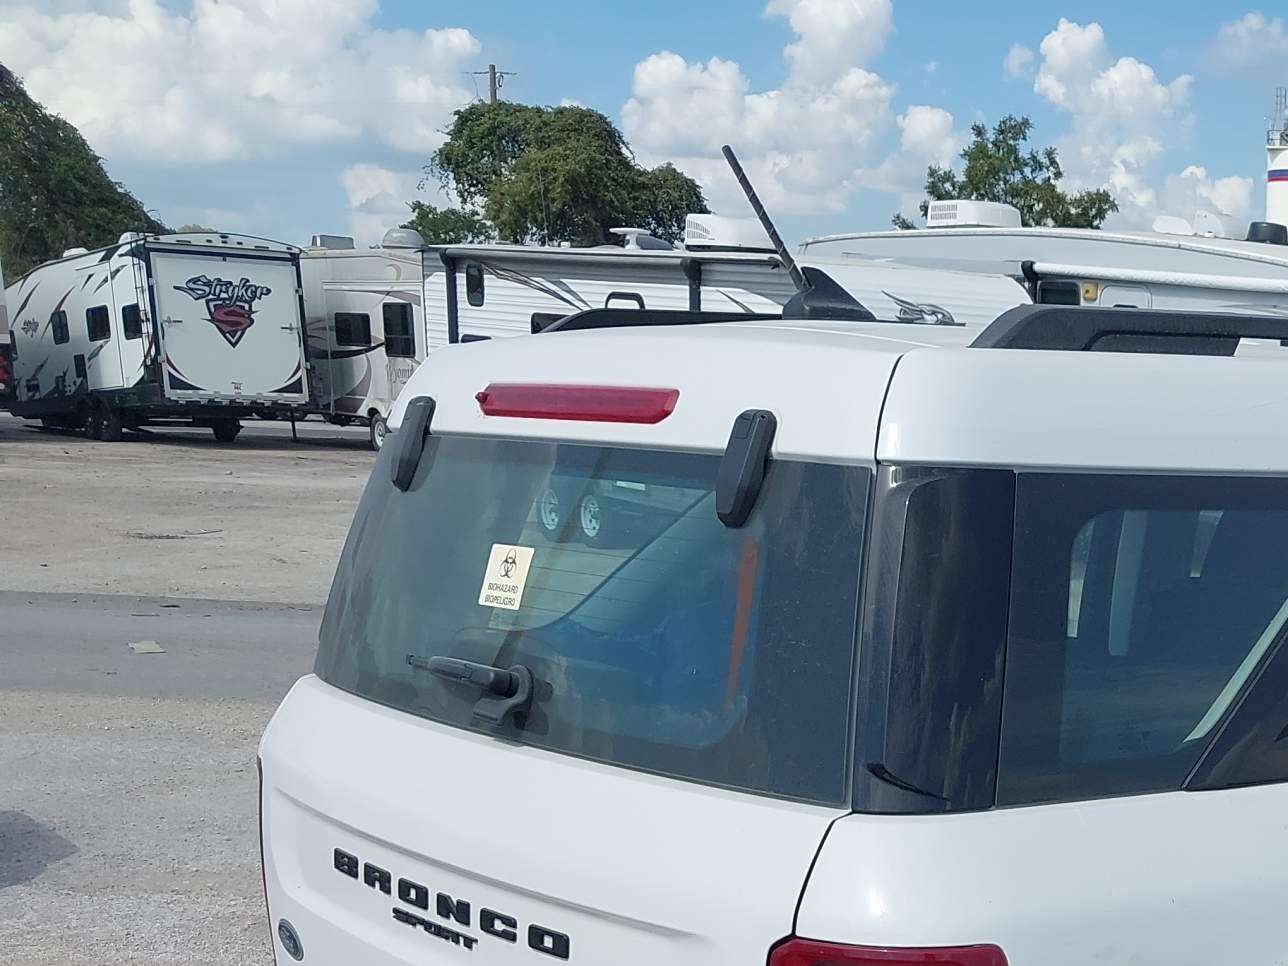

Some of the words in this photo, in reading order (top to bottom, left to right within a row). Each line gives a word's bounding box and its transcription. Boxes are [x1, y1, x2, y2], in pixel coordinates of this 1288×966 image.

[173, 275, 271, 307] Stryker
[484, 594, 516, 607] BIOPELIGRO
[487, 582, 519, 594] BIOHAZARD
[333, 847, 570, 961] BRONCO
[392, 906, 479, 951] SPORT
